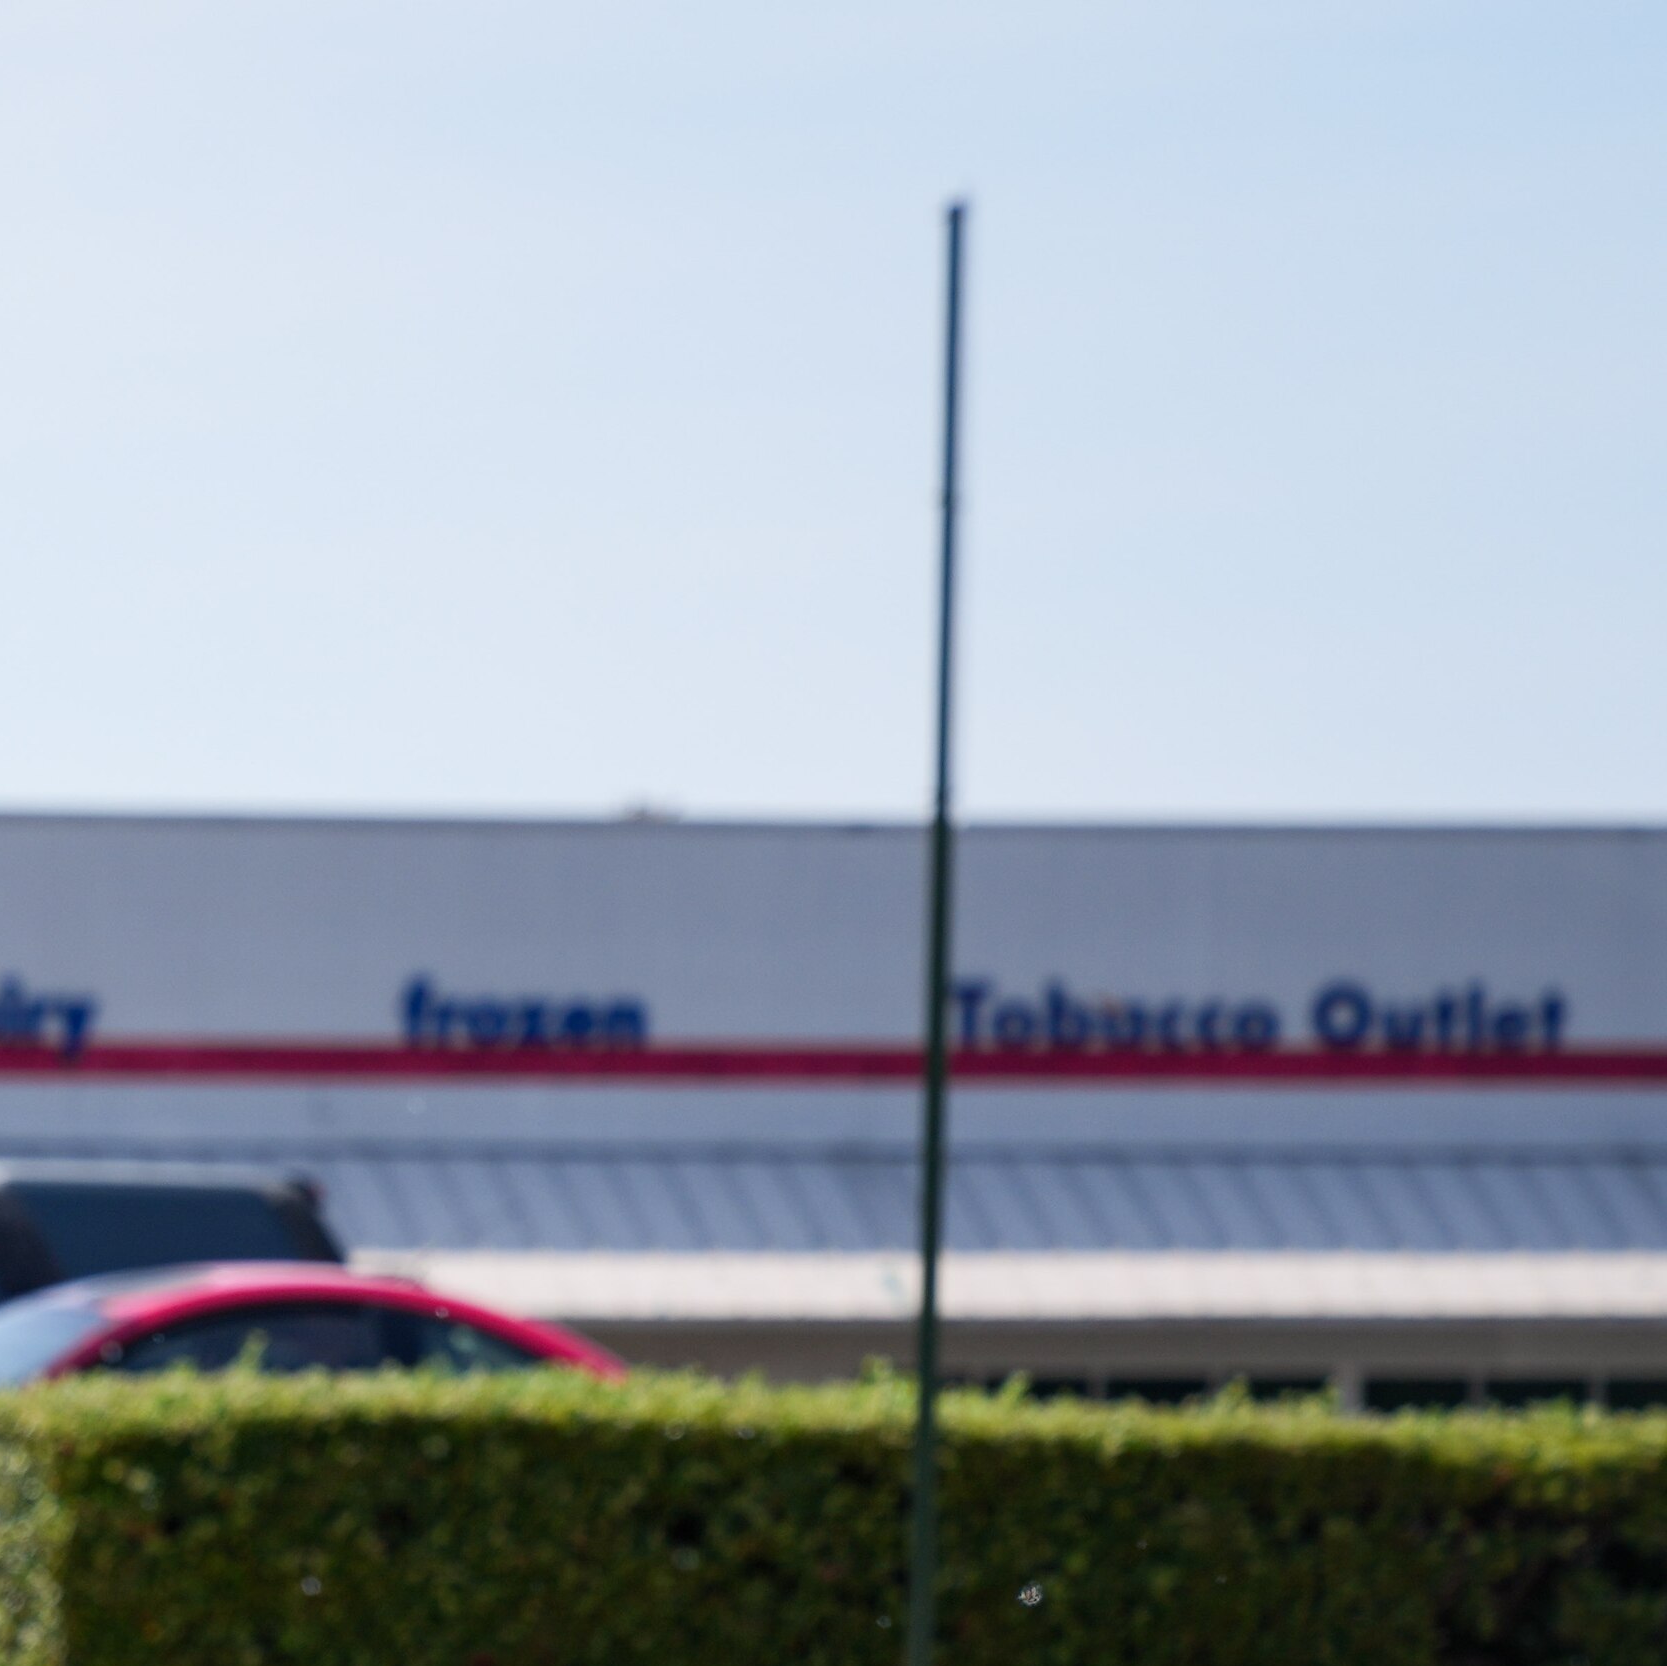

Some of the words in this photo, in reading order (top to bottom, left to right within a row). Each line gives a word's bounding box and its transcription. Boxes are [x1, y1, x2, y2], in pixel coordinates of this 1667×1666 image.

[401, 970, 648, 1048] frozen
[953, 977, 1278, 1048] Tobacco
[1310, 979, 1566, 1048] Outlet
